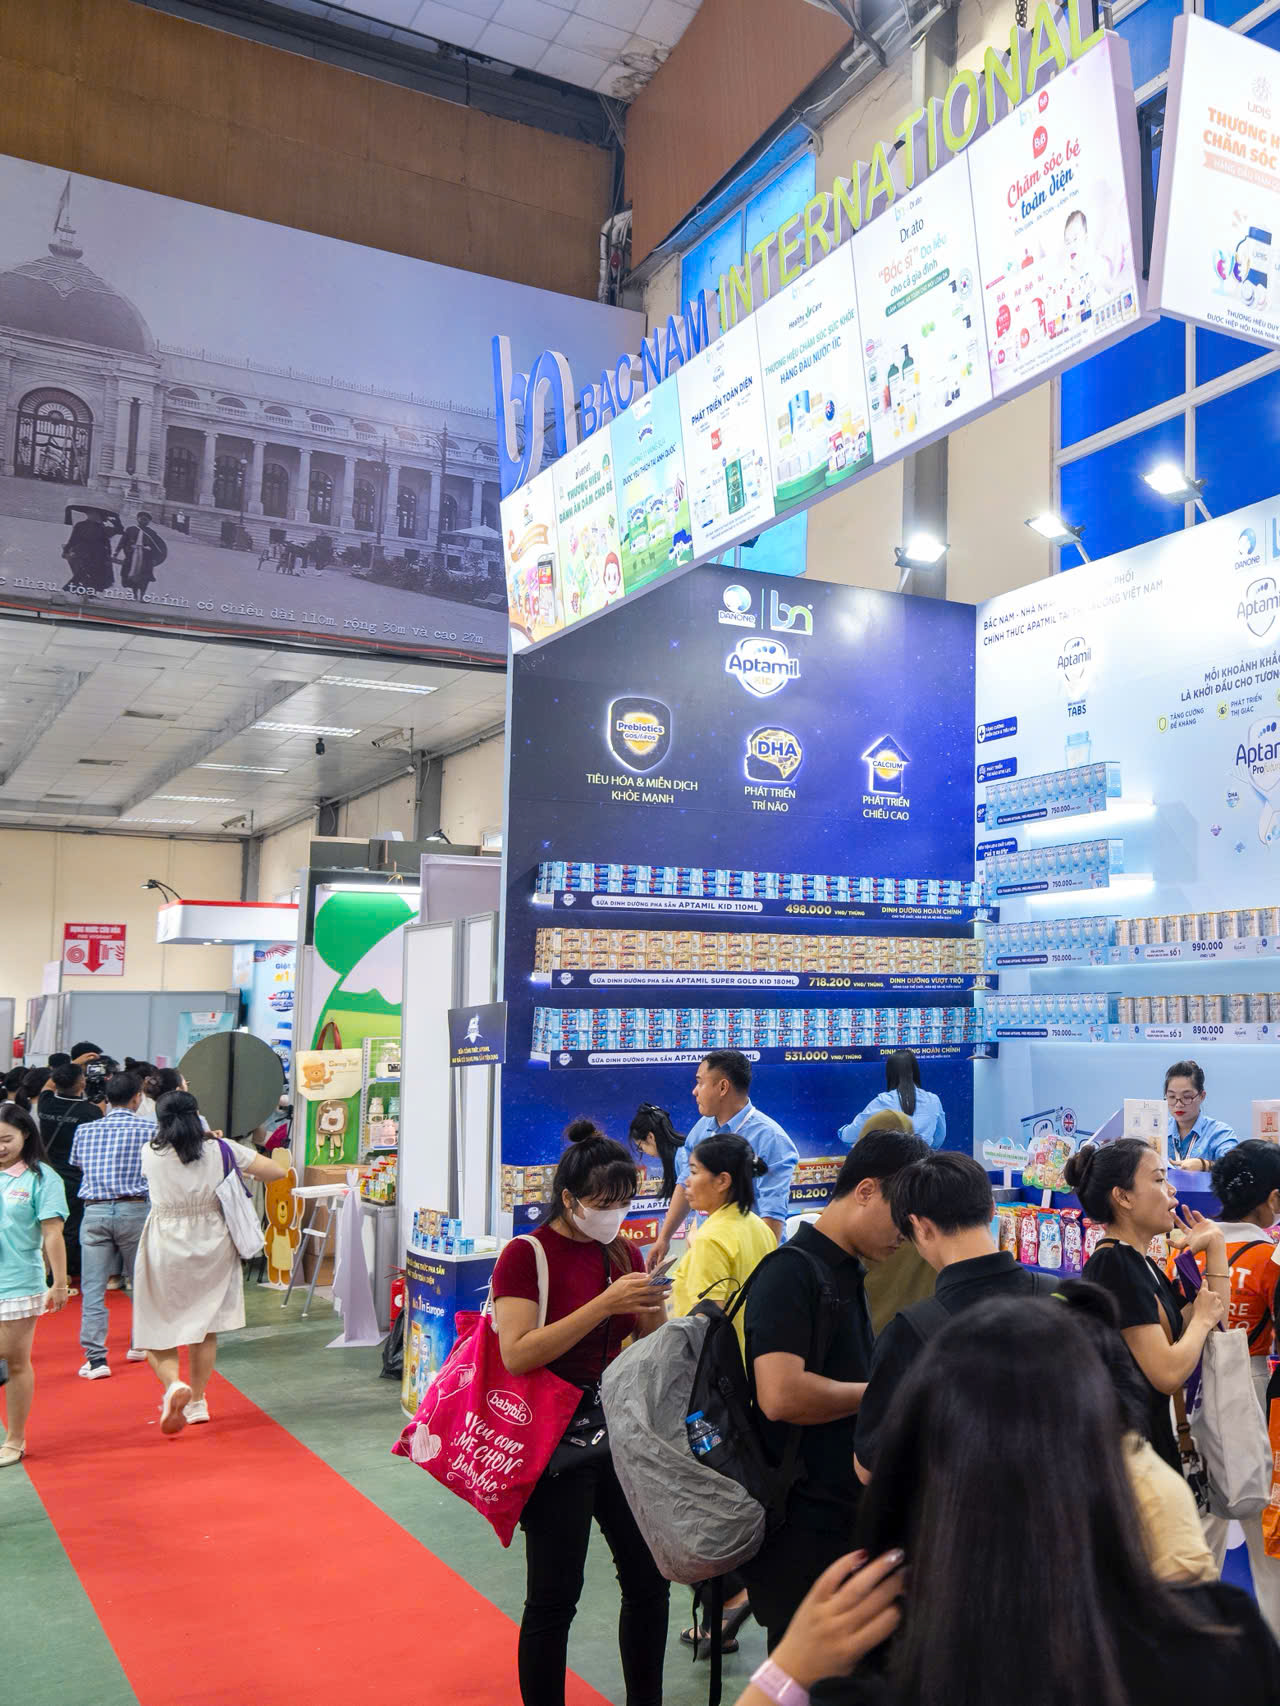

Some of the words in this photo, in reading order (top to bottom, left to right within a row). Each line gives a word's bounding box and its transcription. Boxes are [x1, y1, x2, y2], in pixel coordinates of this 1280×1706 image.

[1207, 106, 1267, 144] THƯƠNG
[1203, 129, 1247, 159] CHĂM
[1249, 143, 1277, 170] SÓC
[1007, 170, 1041, 208] Chăm
[1043, 152, 1064, 176] sóc
[1066, 138, 1081, 161] bé
[1021, 190, 1047, 219] toàn
[1049, 168, 1074, 197] diện
[581, 352, 636, 438] BAC
[641, 290, 710, 384] NAM
[718, 0, 1107, 329] INTERNATIONAL
[900, 218, 925, 244] Dr.ato
[691, 408, 707, 426] PHÁT
[705, 396, 723, 418] TRIỂN
[722, 384, 739, 404] TOÀN
[738, 376, 754, 396] DIỆN
[1234, 555, 1261, 571] DANONE
[68, 580, 97, 597] tòa
[104, 585, 136, 601] nhà
[142, 591, 191, 609] chính
[197, 596, 216, 611] có
[220, 601, 265, 618] chiều
[270, 606, 296, 622] dài
[343, 617, 377, 634] rộng
[382, 622, 407, 635] 30m
[412, 623, 429, 638] và
[434, 630, 457, 642] cao
[462, 632, 484, 645] 27m
[719, 610, 756, 623] DANONE
[983, 616, 997, 631] BẮC
[999, 612, 1015, 627] NAM
[1020, 604, 1036, 618] NHÀ
[728, 653, 800, 679] Aptamil
[1057, 648, 1092, 670] Aptamil
[1203, 665, 1220, 683] MỖI
[1221, 658, 1258, 679] KHOẢNH
[754, 676, 773, 687] KID
[1181, 689, 1192, 702] LÀ
[1193, 679, 1214, 699] KHỞI
[1215, 677, 1233, 694] ĐẦU
[1234, 675, 1253, 690] CHO
[1067, 704, 1087, 718] TABS
[617, 721, 664, 734] Prebiotics
[757, 740, 799, 758] DHA
[872, 760, 904, 770] CALCIUM
[586, 772, 609, 786] TIÊU
[610, 774, 635, 787] HÓA
[636, 777, 645, 788] &
[645, 775, 672, 790] MIỄN
[673, 780, 698, 792] DỊCH
[611, 788, 640, 803] KHỎE
[641, 792, 675, 805] MẠNH
[744, 786, 768, 798] PHÁT
[769, 786, 796, 799] TRIỂN
[751, 799, 766, 811] TRÍ
[767, 799, 789, 813] NÃO
[862, 795, 885, 808] PHÁT
[885, 796, 910, 808] TRIỂN
[1051, 804, 1071, 815] 750.000
[862, 808, 889, 821] CHIỀU
[890, 811, 909, 821] CAO
[596, 899, 610, 907] SỮA
[627, 899, 649, 908] DƯỠNG
[663, 900, 677, 908] SẴN
[678, 901, 715, 910] APTAMIL
[718, 902, 732, 910] KID
[734, 903, 759, 911] 110ML
[785, 904, 832, 915] 498.000
[1192, 941, 1224, 951] 990.000
[808, 977, 851, 987] 718.200
[1192, 1025, 1224, 1035] 890.000
[784, 1050, 829, 1061] 531.000
[620, 1220, 658, 1240] No.1
[425, 1303, 445, 1317] Europe
[489, 1392, 528, 1424] babybio
[451, 1452, 499, 1493] Babybio
